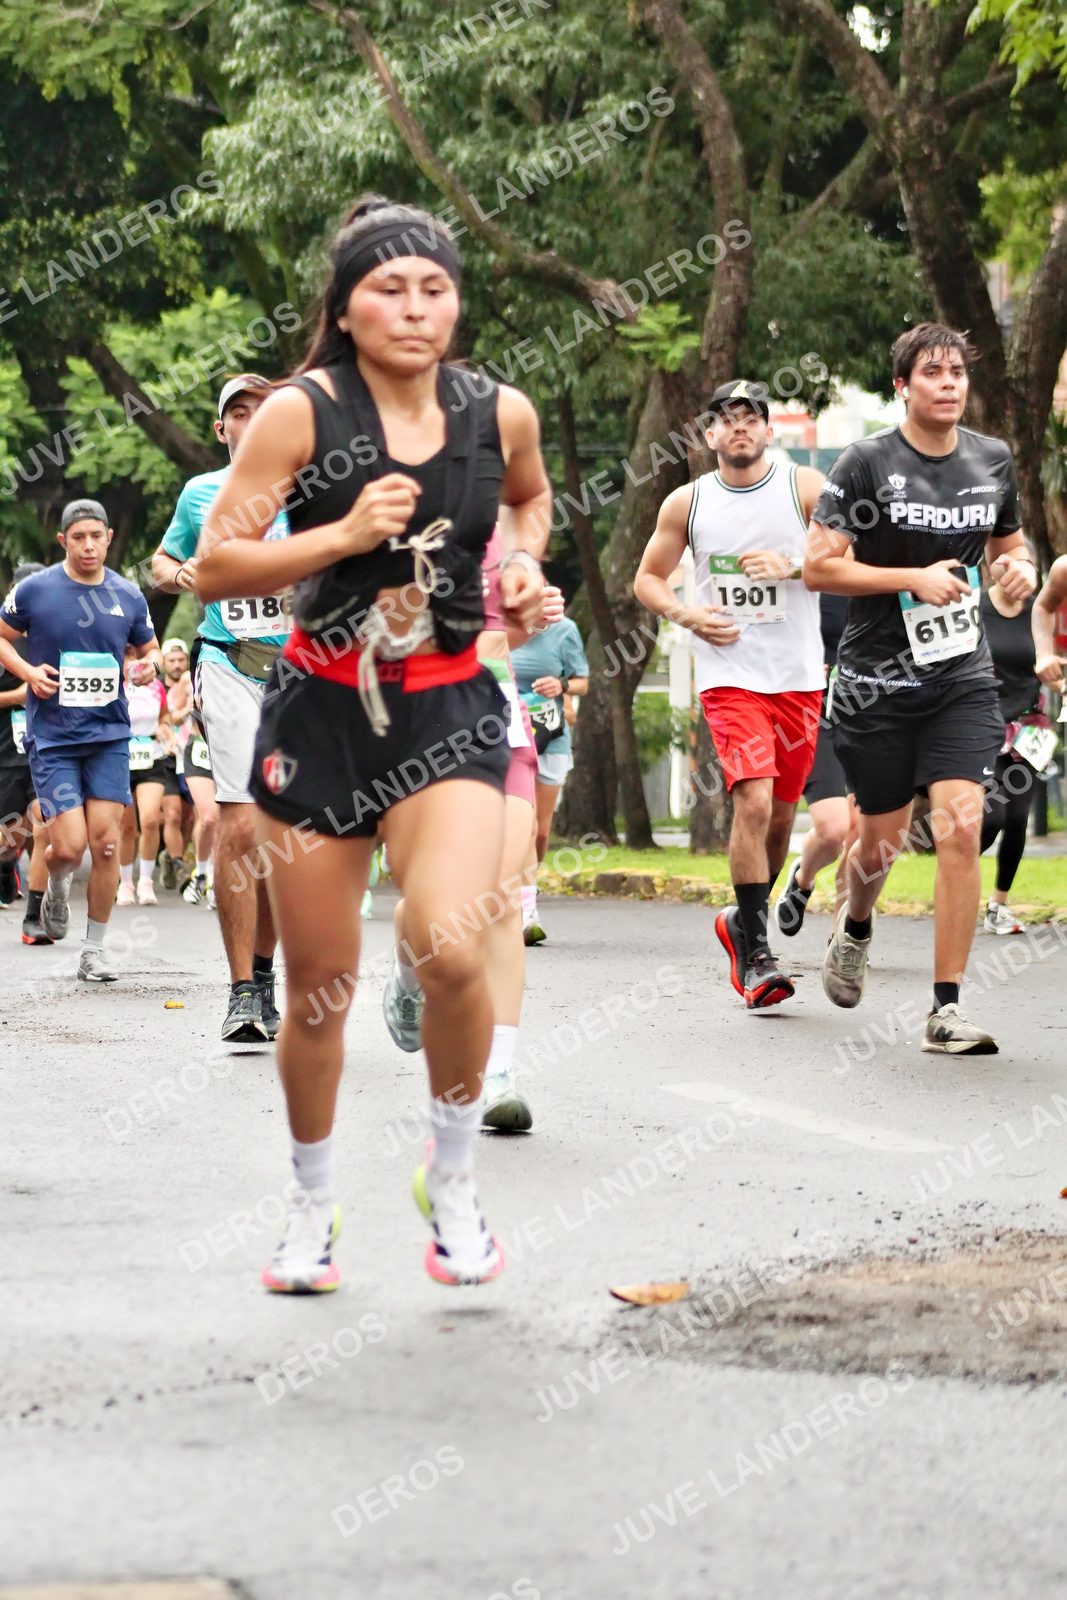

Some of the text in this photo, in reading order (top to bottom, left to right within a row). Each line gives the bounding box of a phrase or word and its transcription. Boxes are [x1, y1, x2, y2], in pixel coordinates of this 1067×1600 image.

[890, 502, 996, 529] PERDURA
[717, 586, 777, 607] 1901
[915, 605, 980, 644] 6150
[63, 677, 115, 693] 3393
